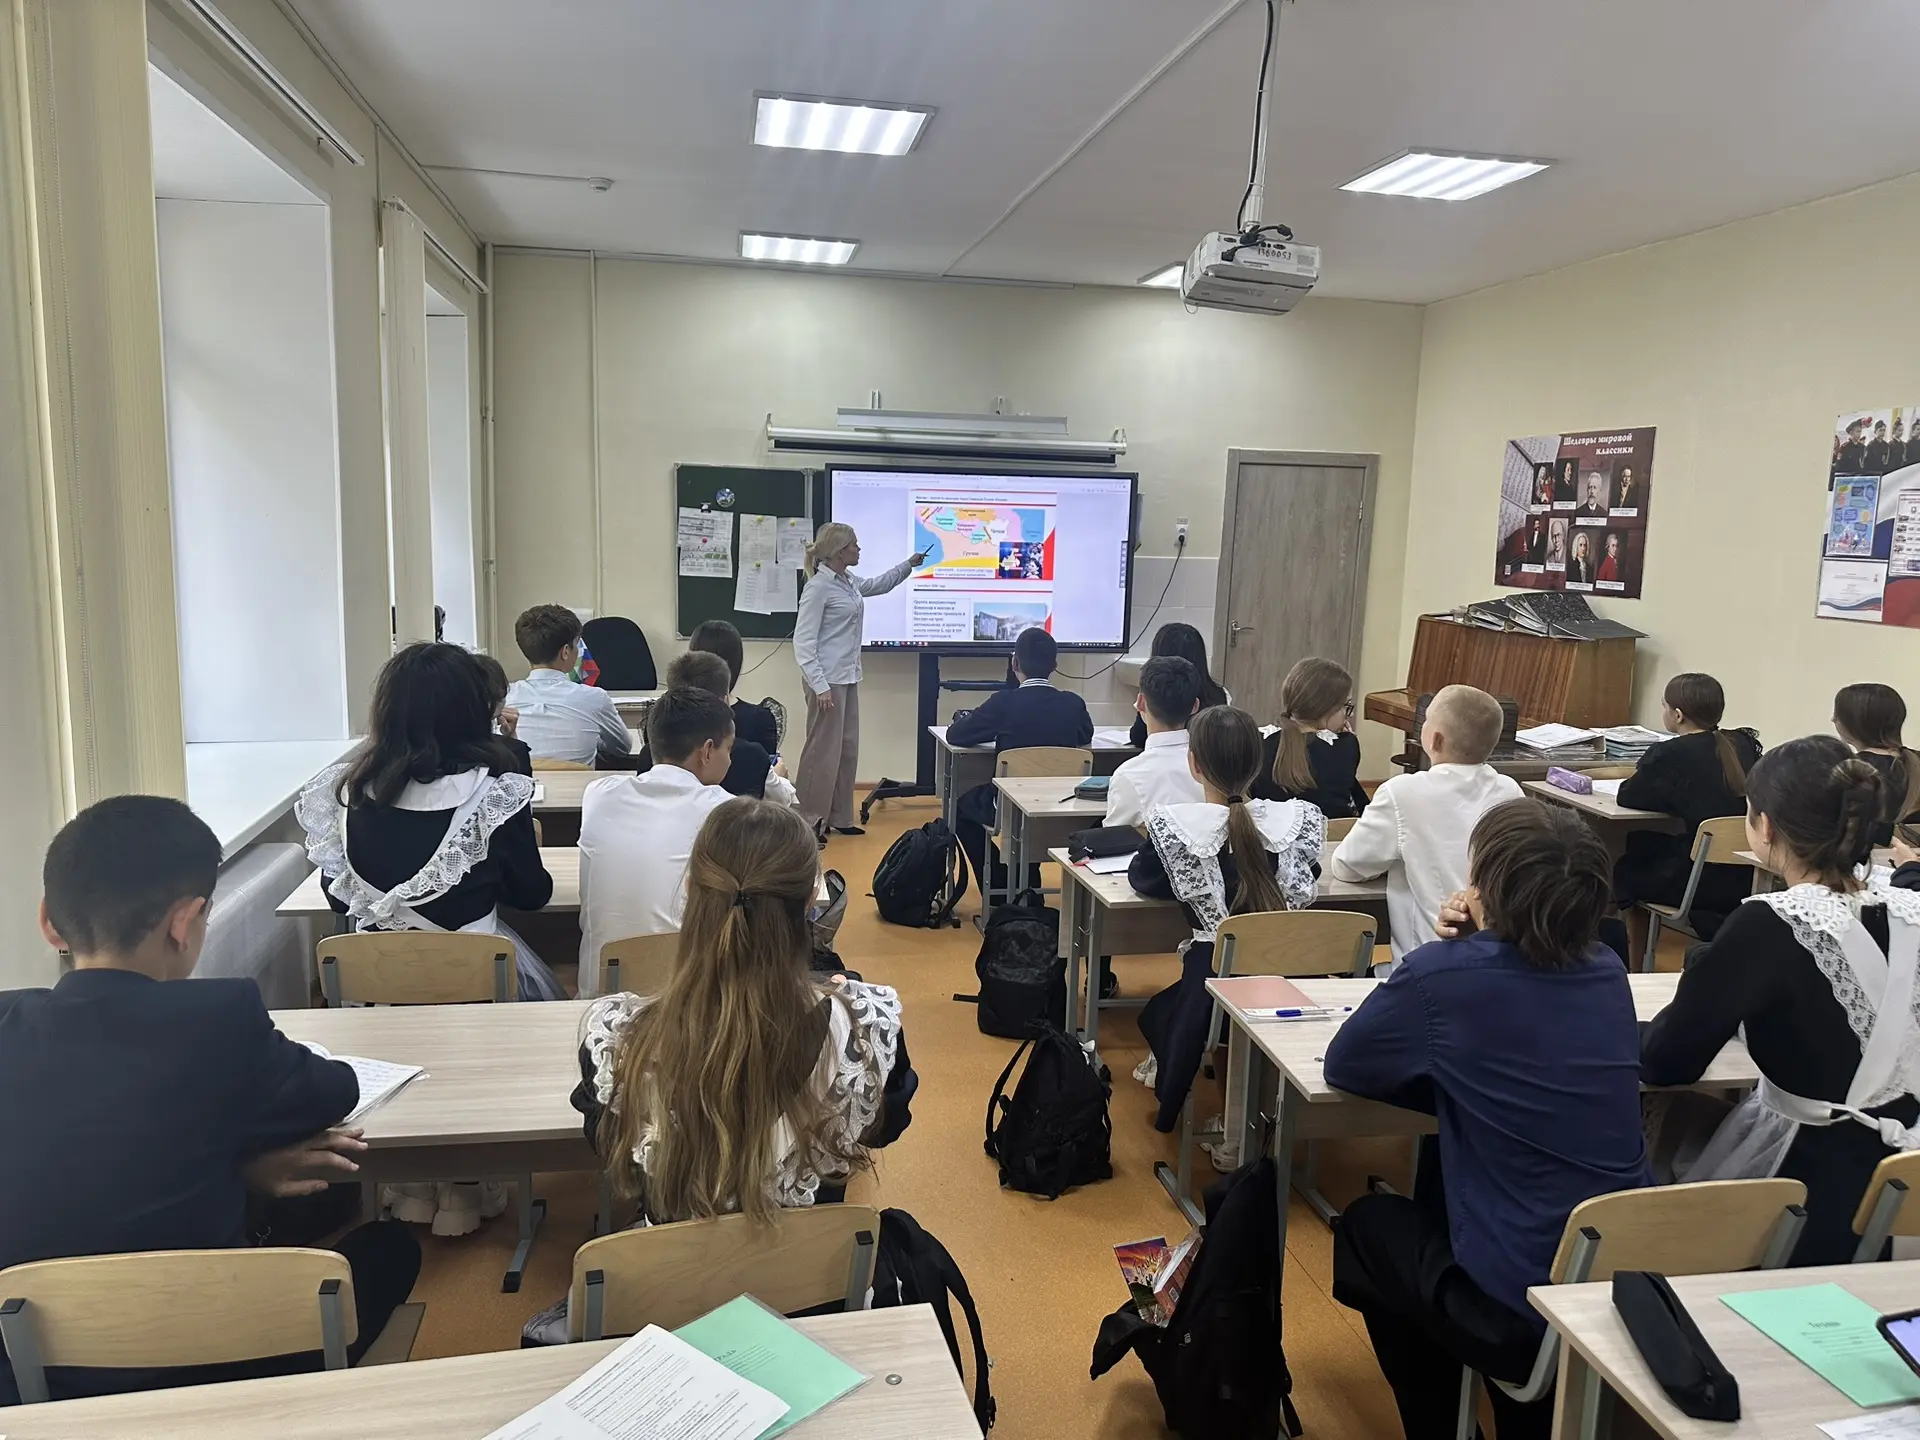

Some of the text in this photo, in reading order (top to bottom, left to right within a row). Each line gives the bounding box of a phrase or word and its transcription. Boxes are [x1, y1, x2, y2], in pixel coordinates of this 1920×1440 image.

[1257, 248, 1292, 261] 1360053
[1563, 433, 1632, 446] Шедевры мировой
[1595, 446, 1633, 455] классики
